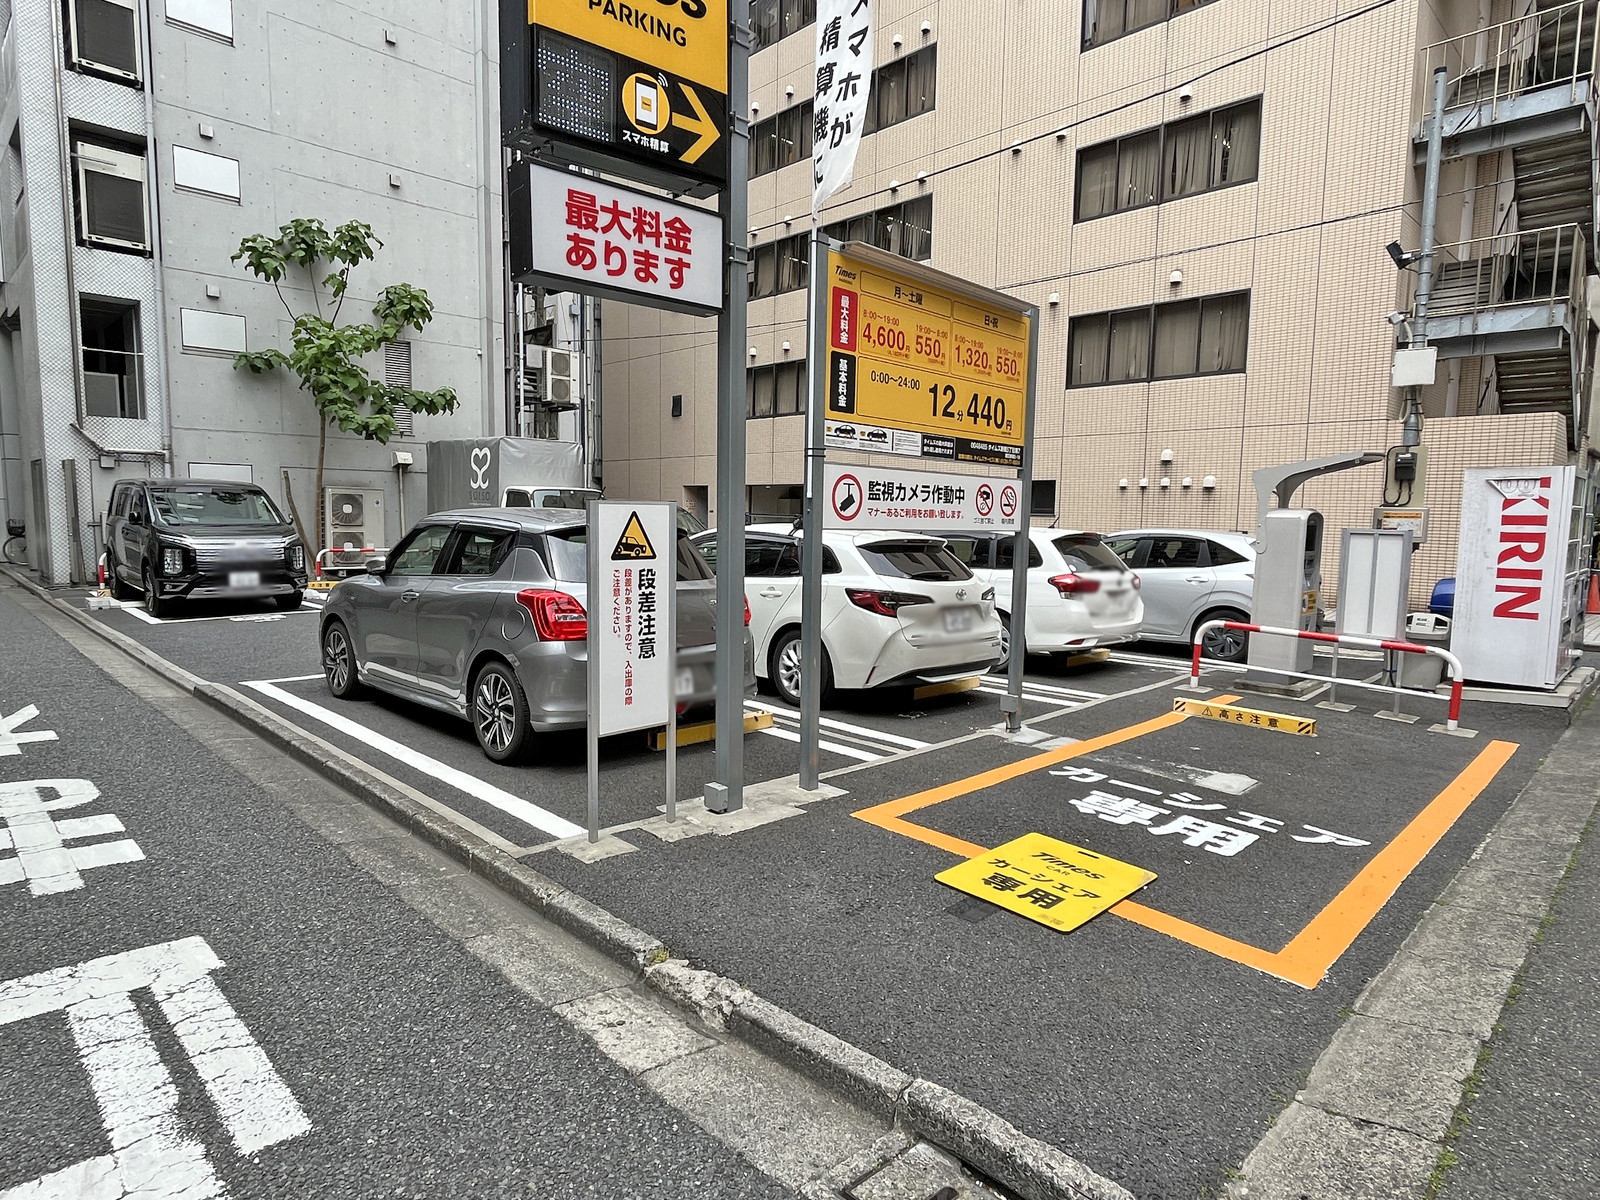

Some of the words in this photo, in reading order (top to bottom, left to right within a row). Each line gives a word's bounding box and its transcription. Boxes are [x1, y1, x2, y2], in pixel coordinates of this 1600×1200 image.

[588, 0, 687, 47] PARKING
[622, 129, 670, 154] スマホ精算
[565, 189, 692, 255] 最大料金
[566, 234, 691, 290] あります
[834, 265, 857, 280] Times
[840, 295, 850, 344] 最大料金
[862, 322, 910, 352] 4,600円
[867, 480, 966, 505] 監視カメラ作動中
[867, 507, 964, 520] マナーあるご利用をお願い致します。
[1493, 476, 1552, 621] KIRIN
[612, 569, 621, 638] ご注意ください。
[638, 568, 656, 659] 段差注意
[1219, 709, 1280, 728] 高さ注意
[1049, 765, 1371, 846] カーシェア
[1068, 790, 1261, 856] 専用
[987, 858, 1102, 899] カーシェア
[1031, 851, 1106, 880] Times
[1046, 865, 1070, 876] CAR
[981, 872, 1067, 910] 専用
